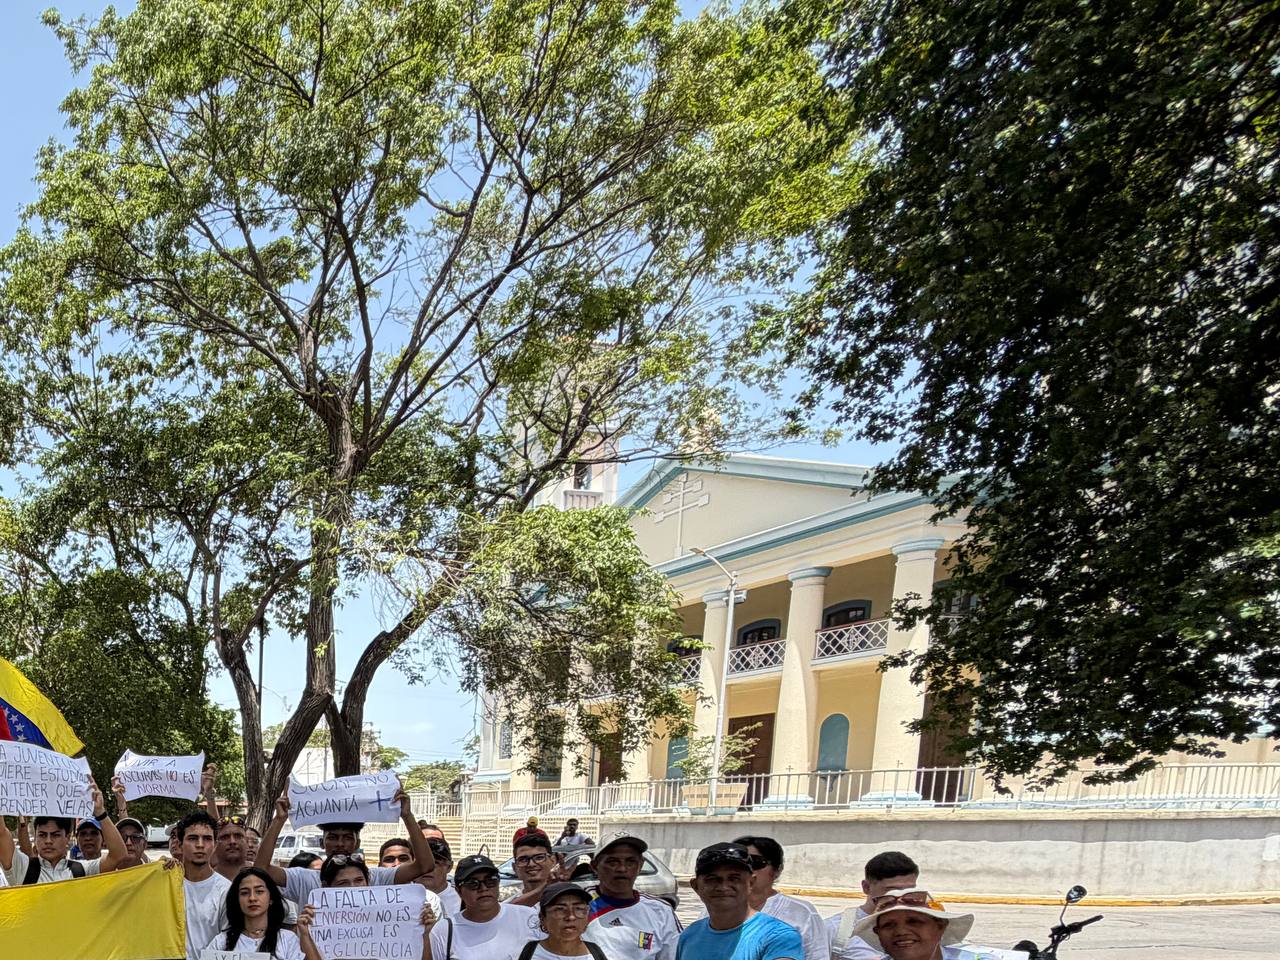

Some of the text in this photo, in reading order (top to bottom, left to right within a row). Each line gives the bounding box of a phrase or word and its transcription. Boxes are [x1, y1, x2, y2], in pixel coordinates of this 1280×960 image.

[165, 759, 176, 767] A
[118, 769, 196, 784] OSCURAS NO ES
[365, 773, 389, 785] NO
[11, 782, 49, 798] TENER
[56, 784, 82, 798] QUE
[137, 783, 180, 795] NORMAL
[56, 799, 94, 817] VELAS
[312, 886, 405, 910] LA FALTA DE
[312, 905, 411, 927] INVERSIÓN NO ES
[310, 923, 400, 943] UNA EXCUSA ES
[318, 940, 413, 960] EGLIGENCIA
